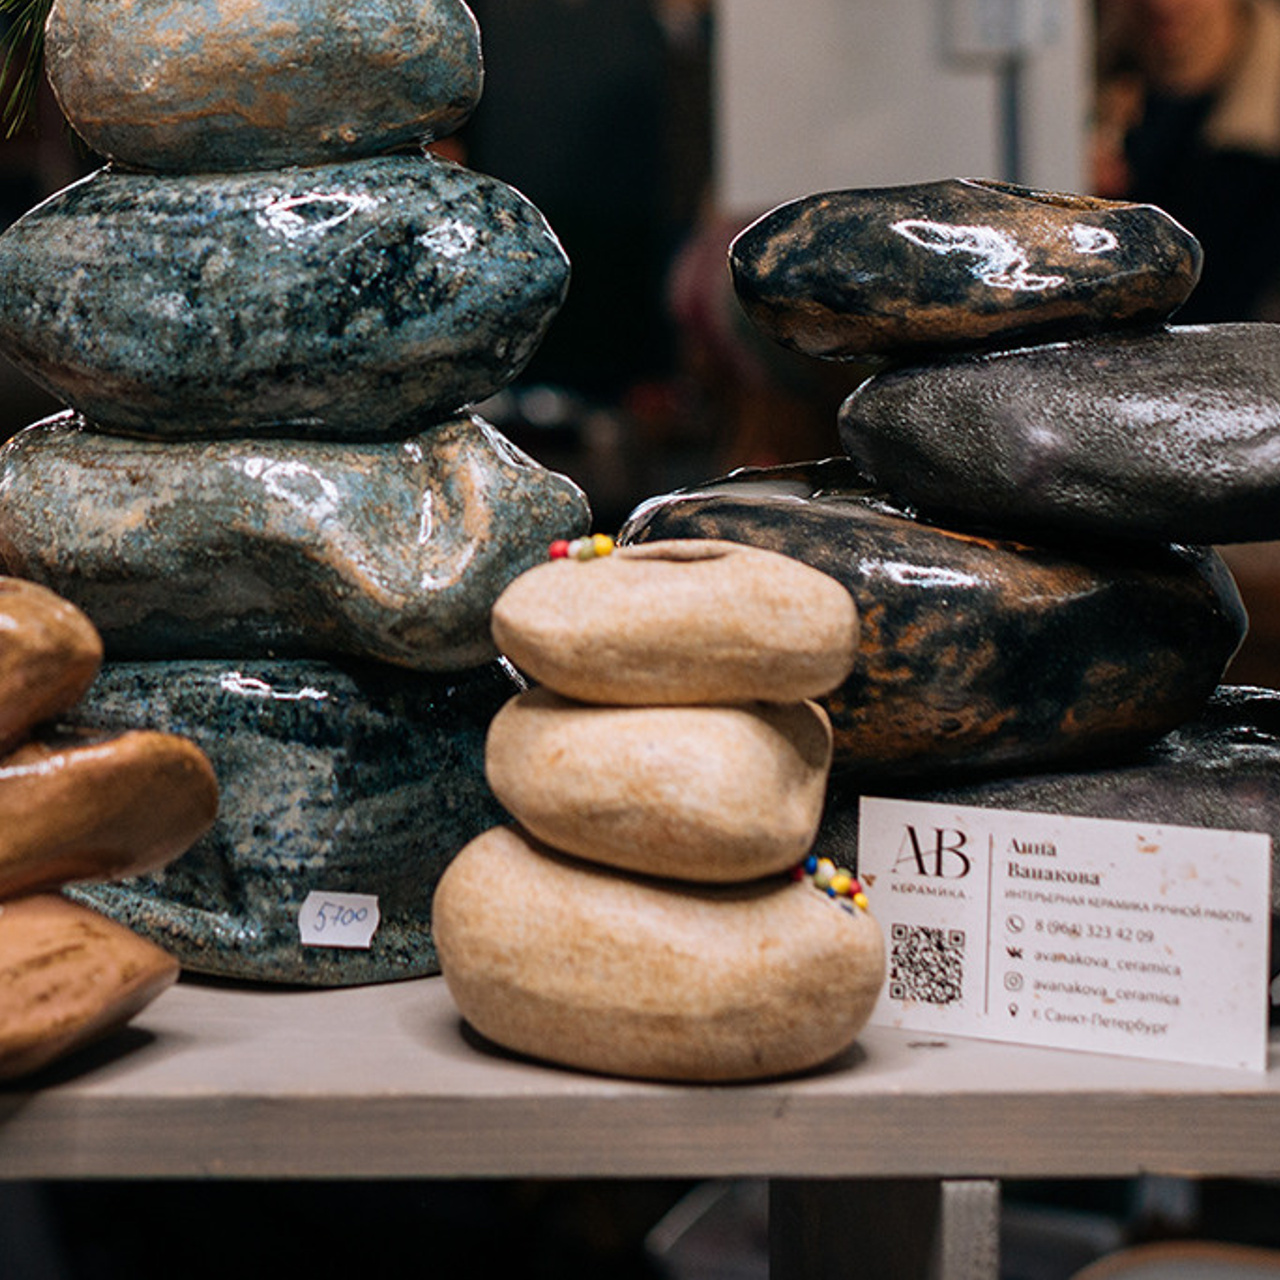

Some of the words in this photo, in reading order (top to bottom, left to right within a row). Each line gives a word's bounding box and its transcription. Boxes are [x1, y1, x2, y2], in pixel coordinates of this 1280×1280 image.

[1006, 838, 1057, 857] Анна
[1007, 861, 1100, 886] Ванакова
[891, 883, 966, 899] КЕРАМИКА
[1035, 919, 1044, 932] 8
[1086, 923, 1112, 939] 323
[1116, 926, 1133, 941] 42
[1136, 929, 1155, 943] 09
